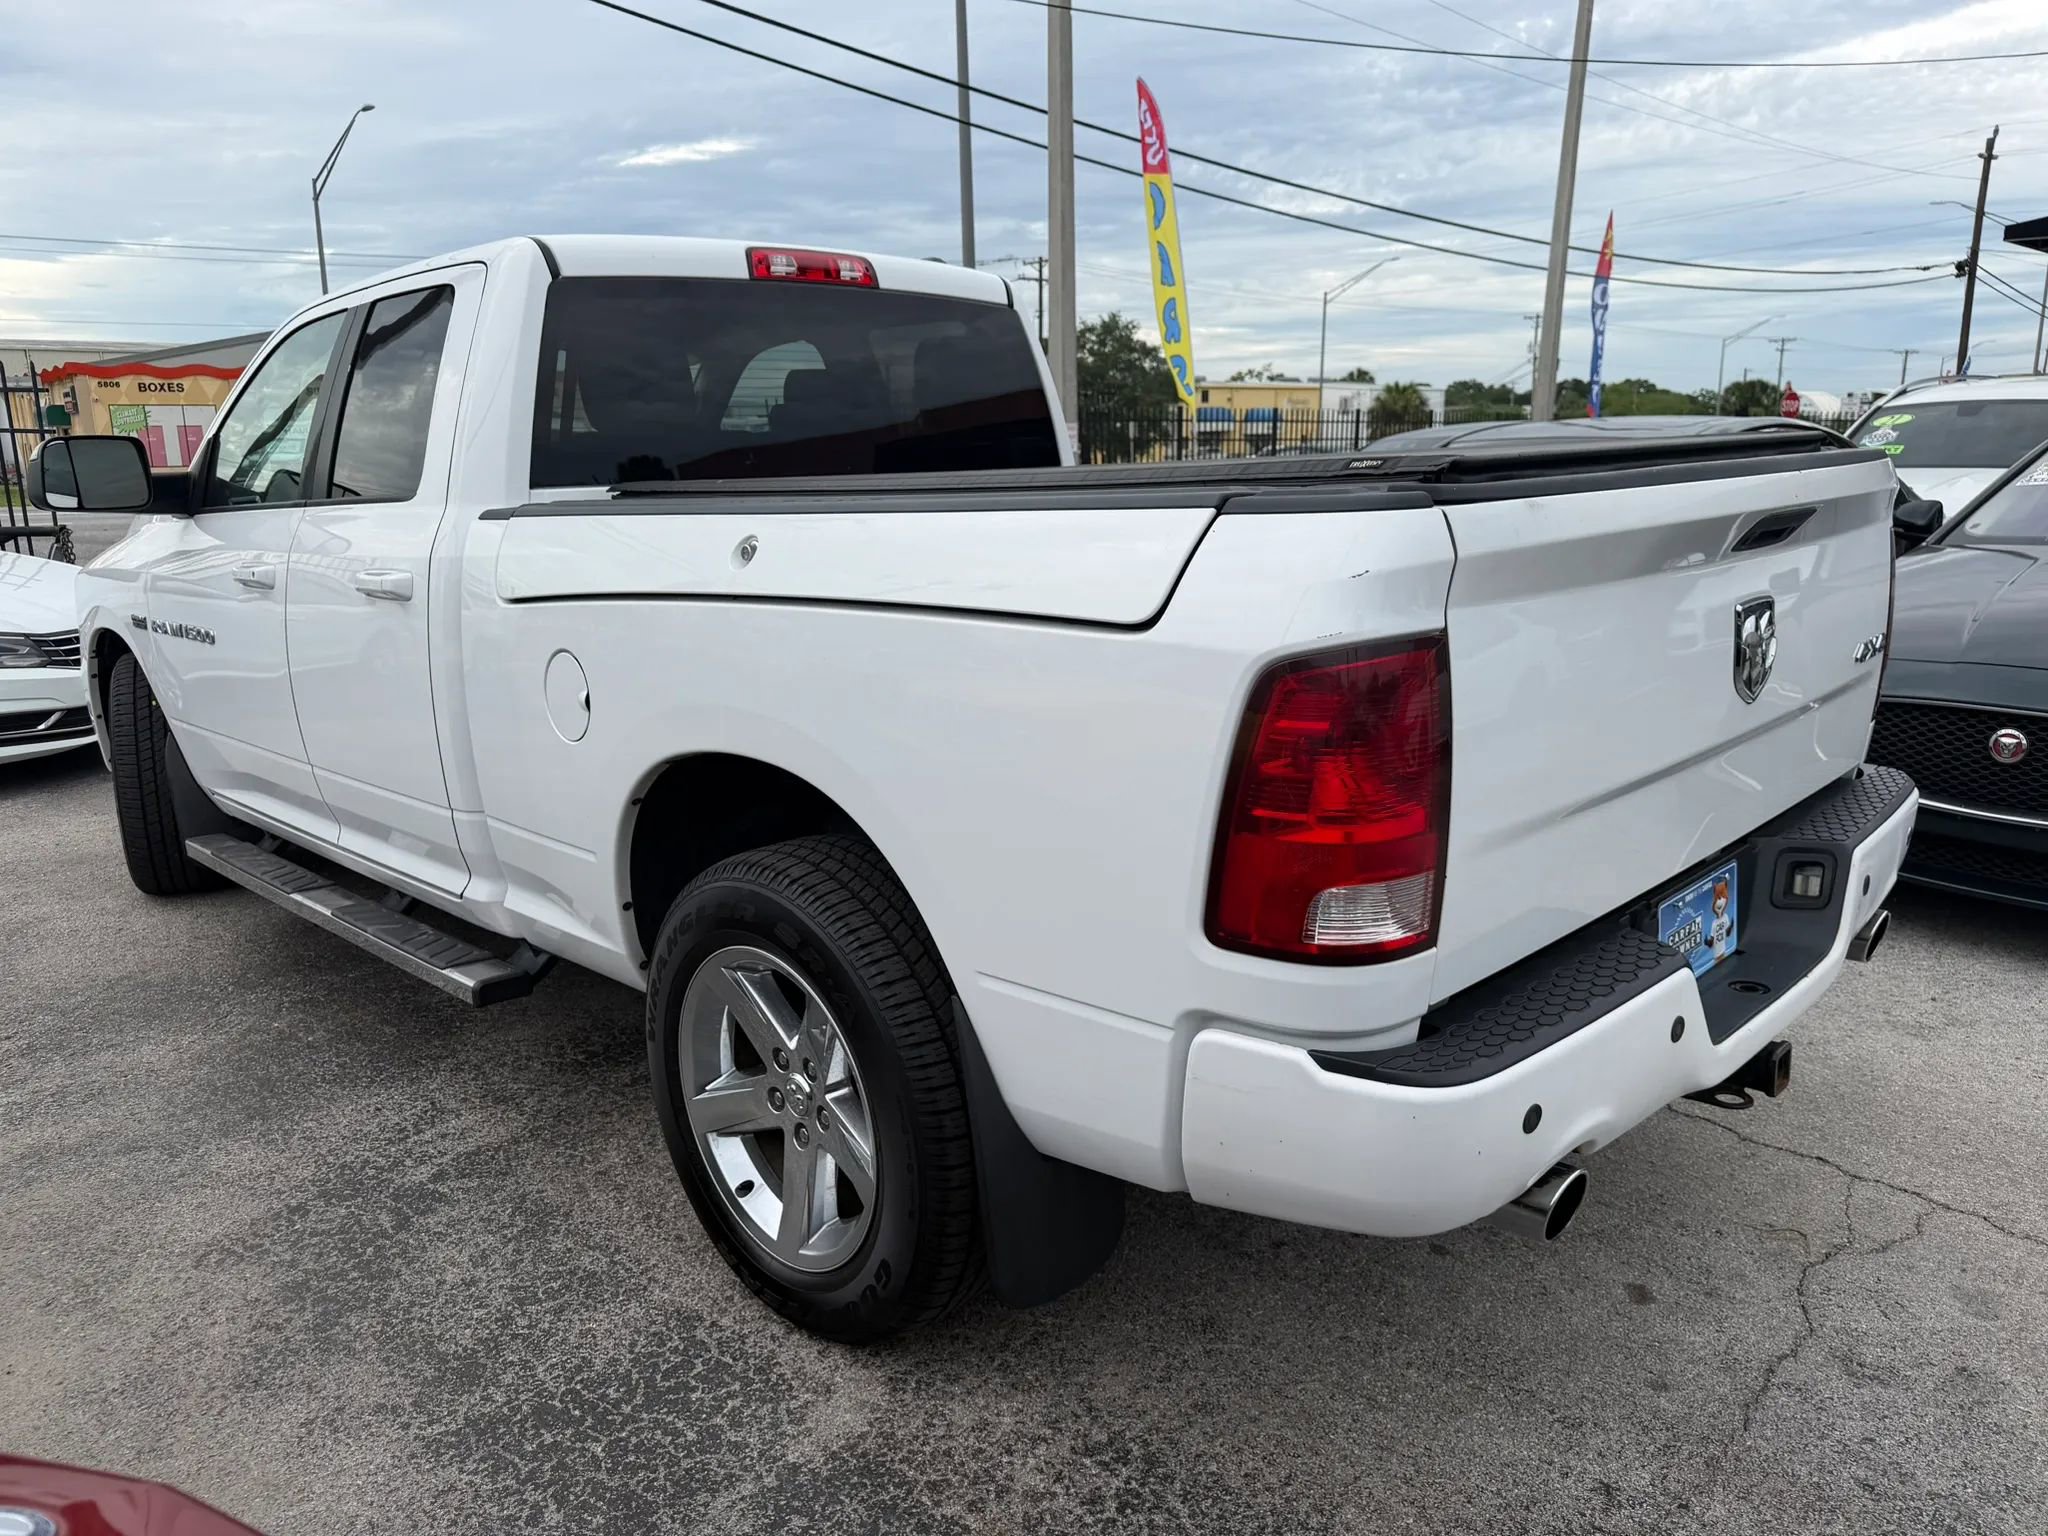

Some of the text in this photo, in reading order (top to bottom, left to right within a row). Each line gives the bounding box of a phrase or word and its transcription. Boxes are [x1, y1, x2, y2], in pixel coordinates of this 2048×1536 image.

[138, 382, 185, 393] BOXES
[1782, 400, 1799, 412] STOP
[151, 619, 184, 638] RAM
[1676, 933, 1701, 953] WNER
